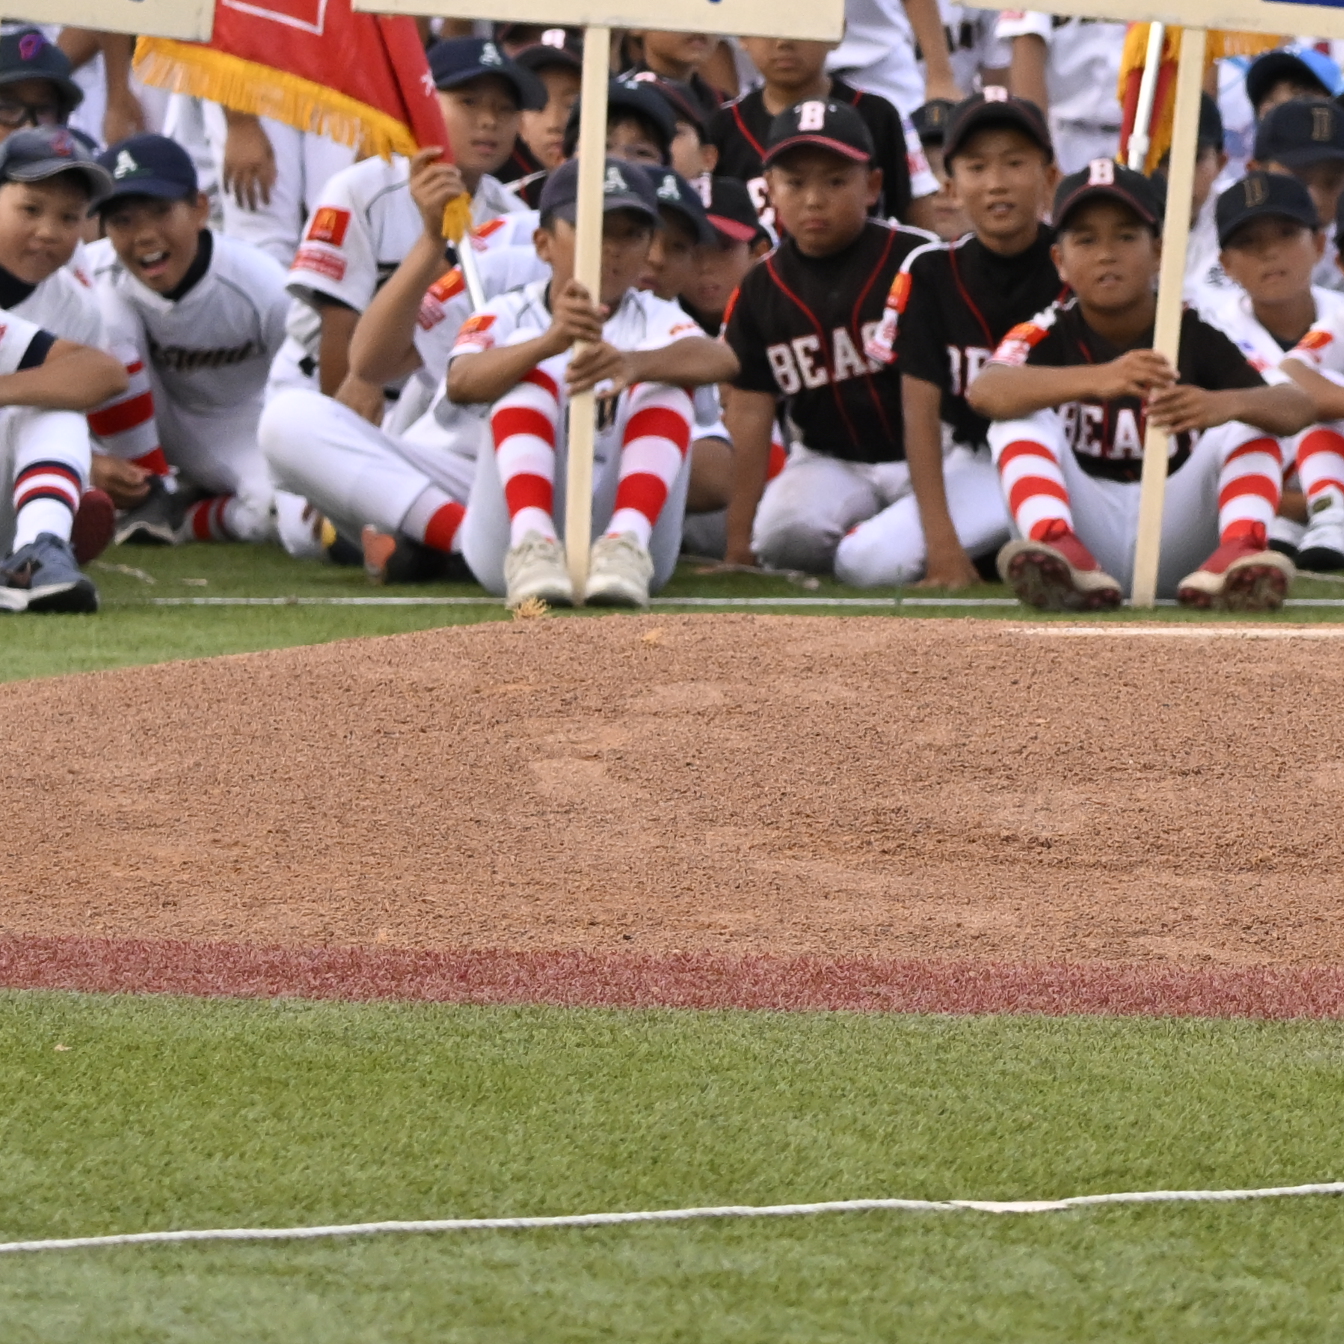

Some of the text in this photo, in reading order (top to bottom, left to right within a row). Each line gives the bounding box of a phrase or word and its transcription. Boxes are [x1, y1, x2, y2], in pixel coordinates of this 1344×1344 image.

[797, 101, 824, 131] B
[113, 150, 138, 178] A
[1088, 158, 1115, 186] B
